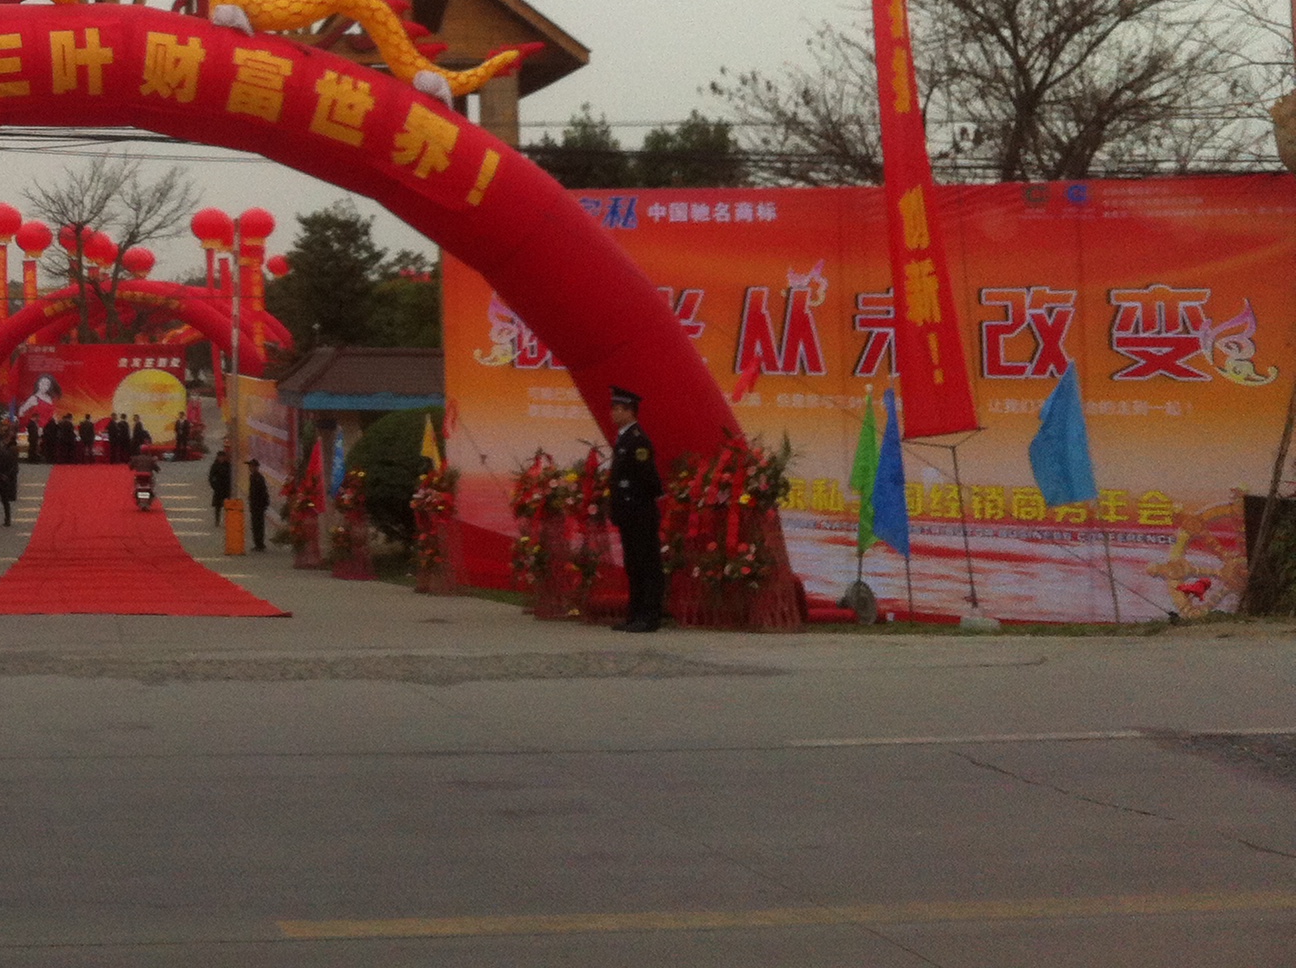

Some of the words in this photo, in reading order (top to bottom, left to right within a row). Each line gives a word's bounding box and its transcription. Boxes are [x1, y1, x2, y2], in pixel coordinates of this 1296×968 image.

[647, 201, 778, 223] 中国驰名商标
[782, 478, 1175, 526] 家私国经销商务年会
